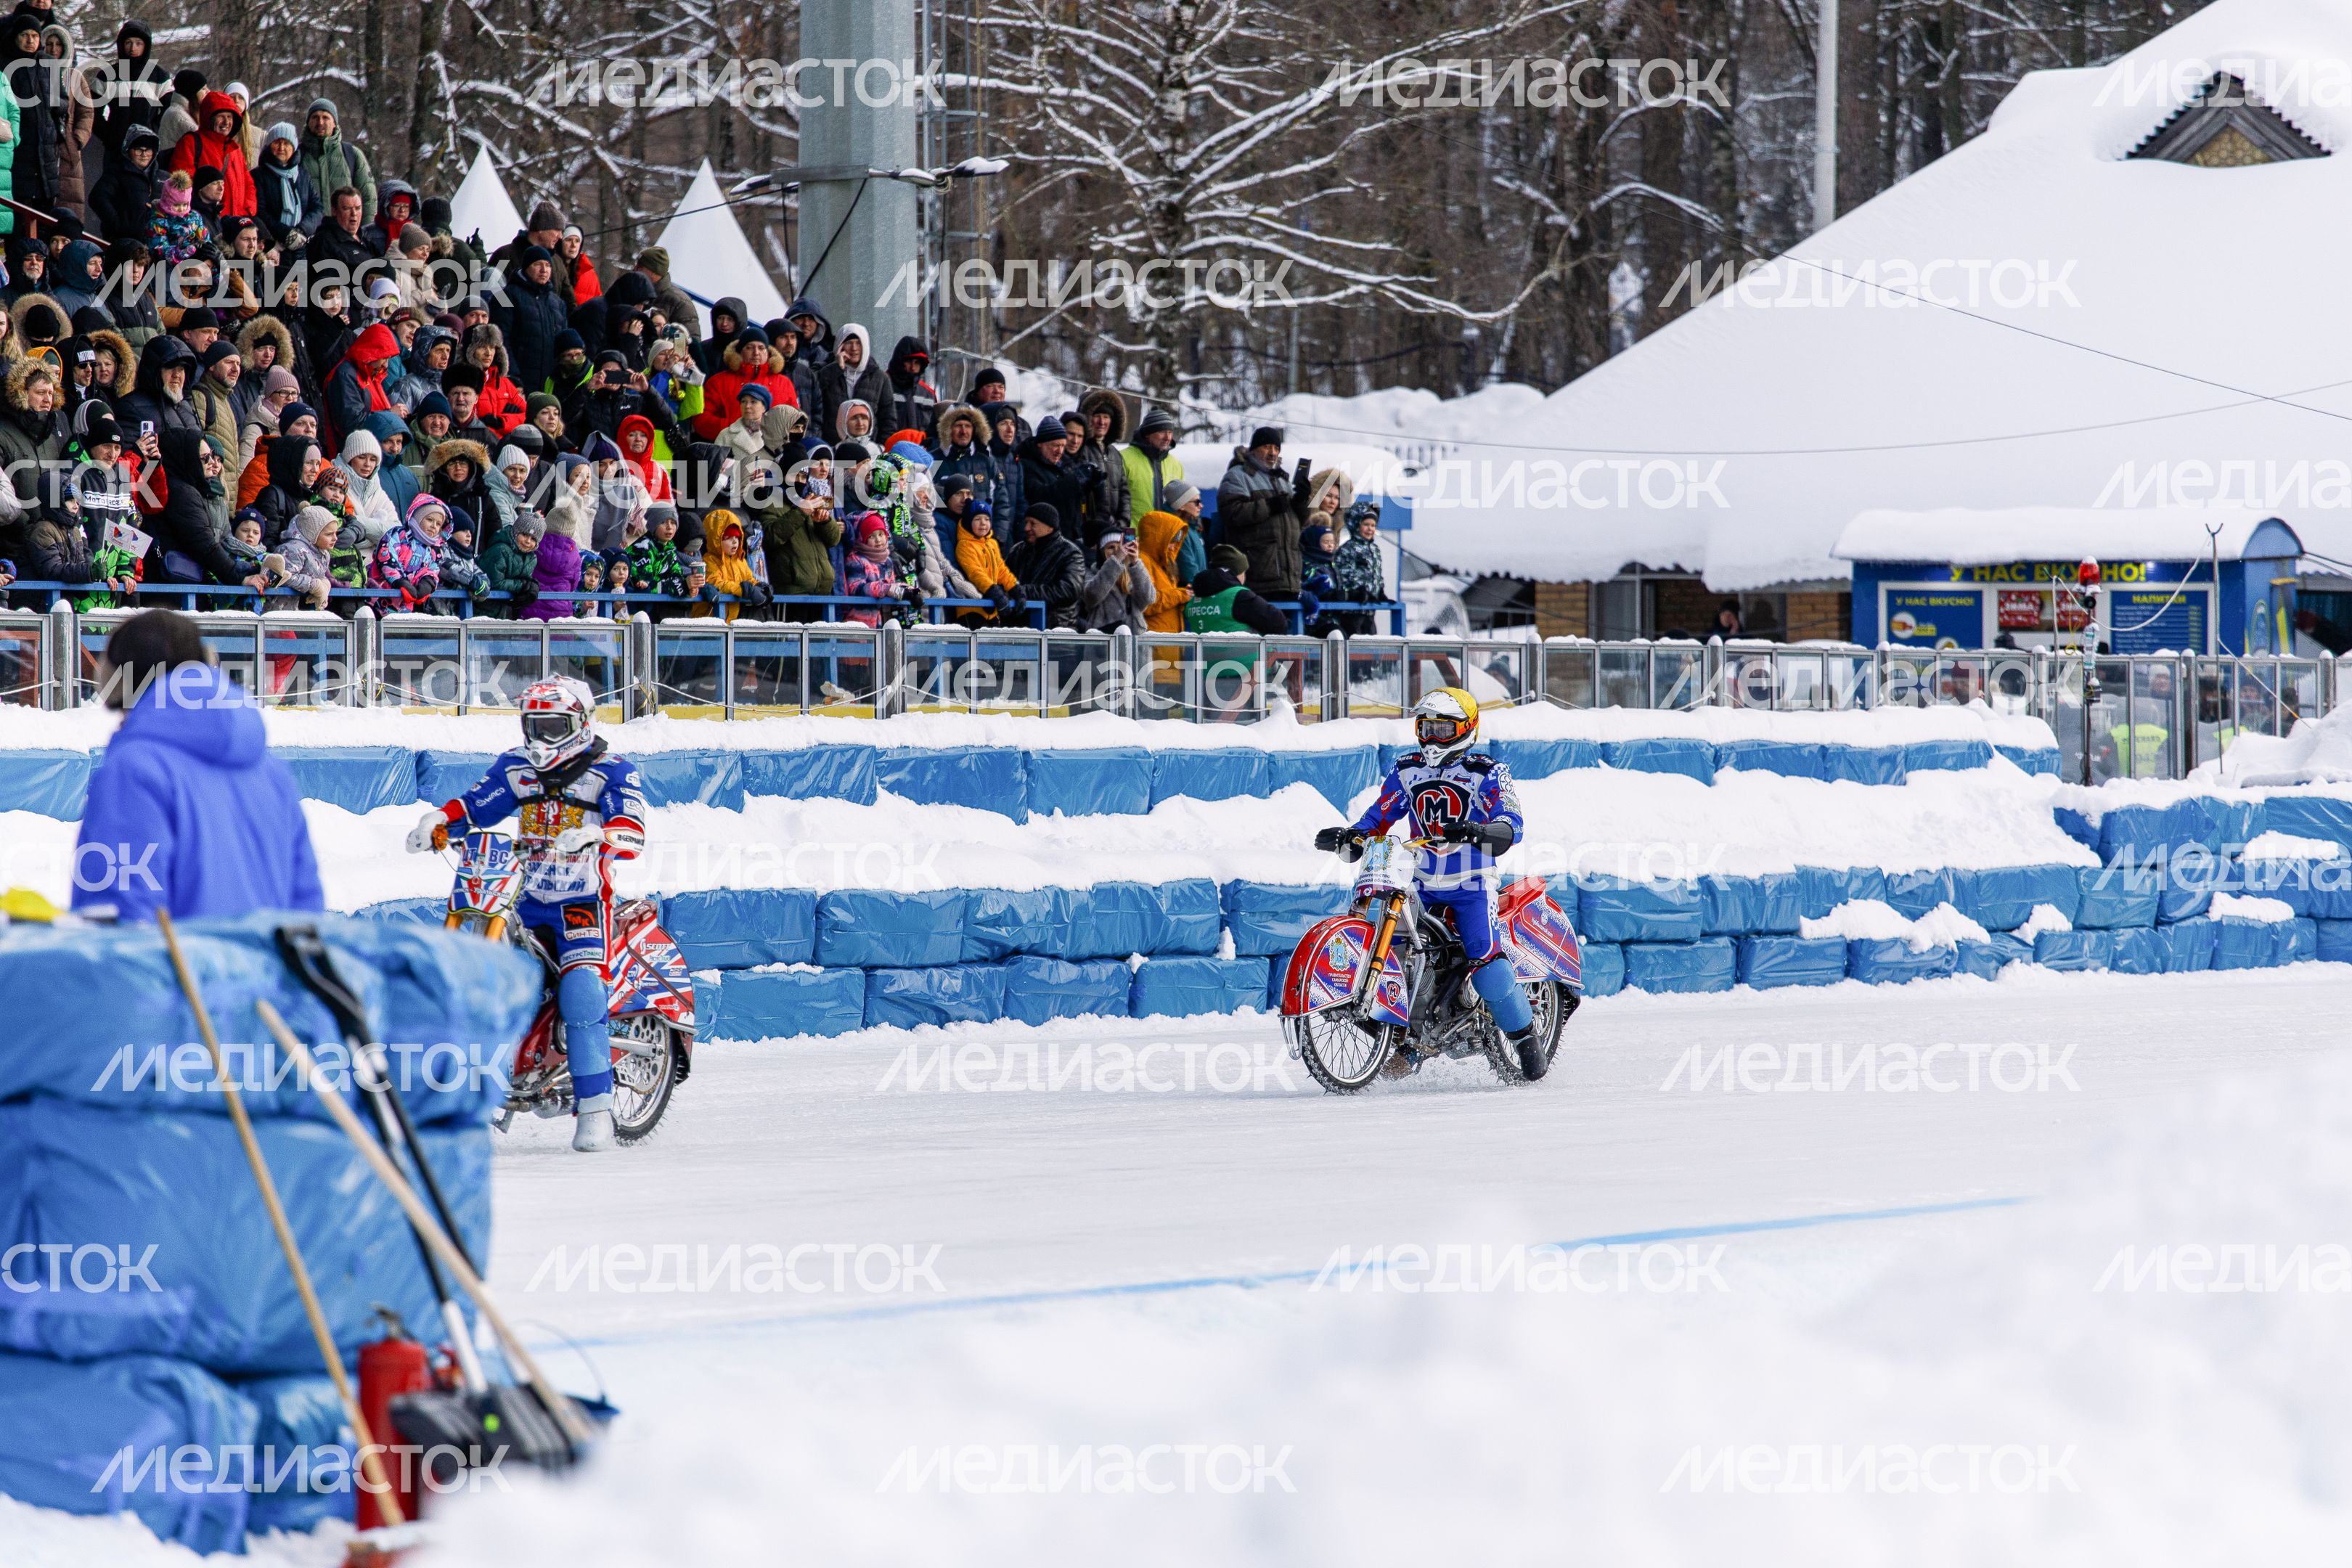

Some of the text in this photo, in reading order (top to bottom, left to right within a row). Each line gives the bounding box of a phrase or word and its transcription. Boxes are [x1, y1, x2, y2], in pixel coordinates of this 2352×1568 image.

[1973, 563, 2026, 581] НАС
[2034, 563, 2147, 581] ВКУНО!
[1188, 605, 1221, 617] ПРЕССА
[1198, 620, 1204, 629] 3
